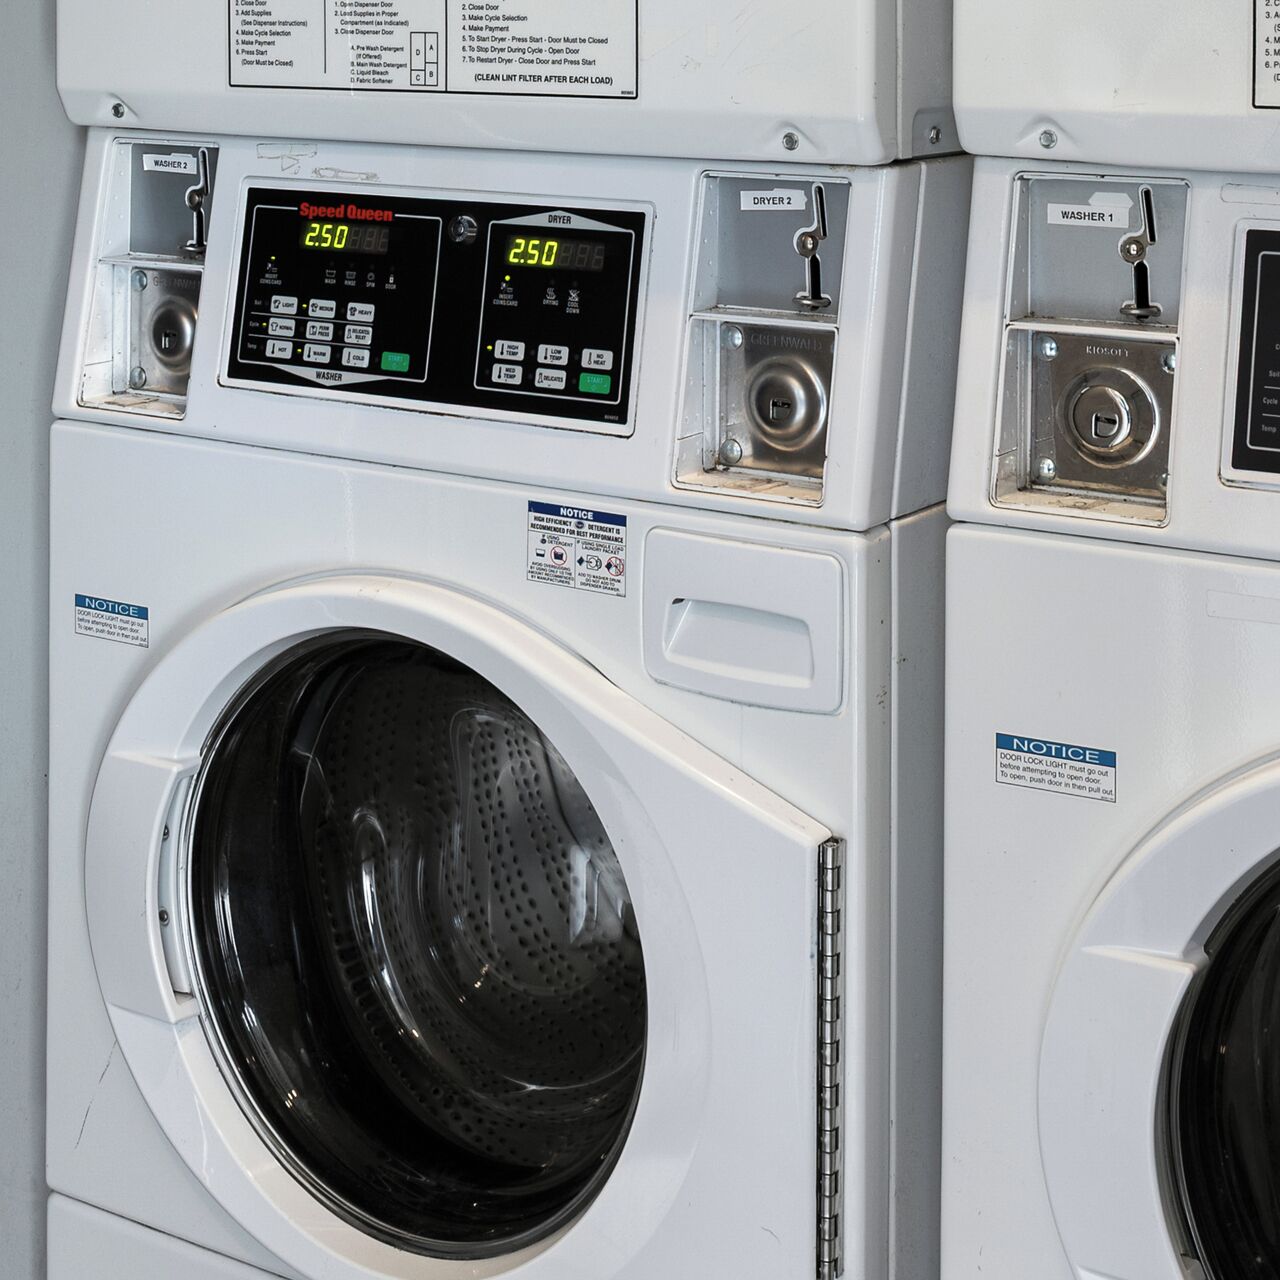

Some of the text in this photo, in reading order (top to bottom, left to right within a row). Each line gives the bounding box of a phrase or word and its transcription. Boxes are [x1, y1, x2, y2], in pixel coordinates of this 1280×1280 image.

[475, 74, 500, 82] (CLEAN
[570, 76, 589, 84] EACH
[591, 77, 613, 85] LOAD)
[154, 159, 181, 168] WASHER
[753, 196, 792, 205] DRYER 2
[300, 202, 393, 222] Speed Queen
[1061, 211, 1113, 222] WASHER 1
[548, 215, 571, 224] DRYER
[305, 223, 348, 249] 2.50
[509, 238, 558, 266] 2.50
[316, 371, 342, 381] WASHER
[560, 508, 593, 519] NOTICE
[86, 598, 138, 616] NOTICE
[1013, 739, 1099, 763] NOTICE
[1000, 753, 1022, 762] DOOR
[1024, 757, 1044, 765] LOCK
[1046, 760, 1067, 769] LIGHT
[1069, 765, 1085, 773] must
